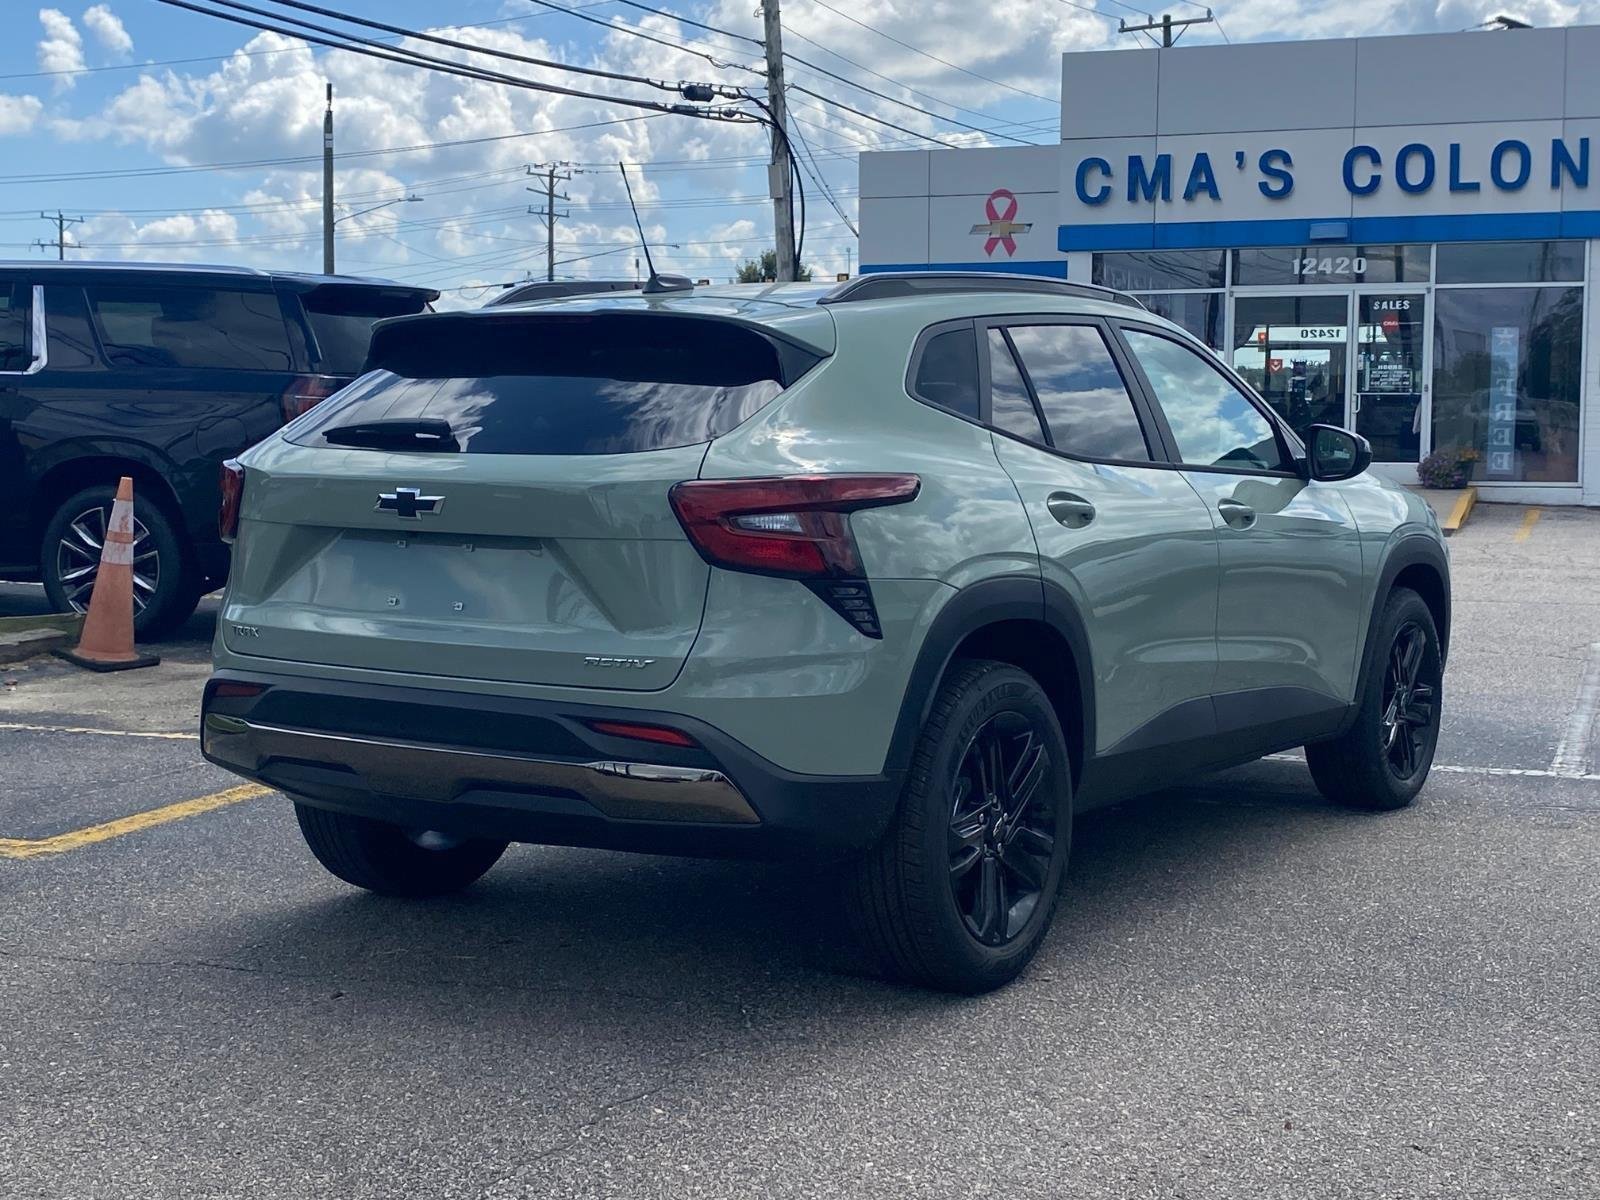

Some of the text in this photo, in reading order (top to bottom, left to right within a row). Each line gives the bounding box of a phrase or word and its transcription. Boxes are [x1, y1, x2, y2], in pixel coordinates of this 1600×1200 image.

[1075, 137, 1590, 206] CMA'S COLON
[1292, 256, 1368, 275] 12420
[1373, 300, 1410, 310] SALES
